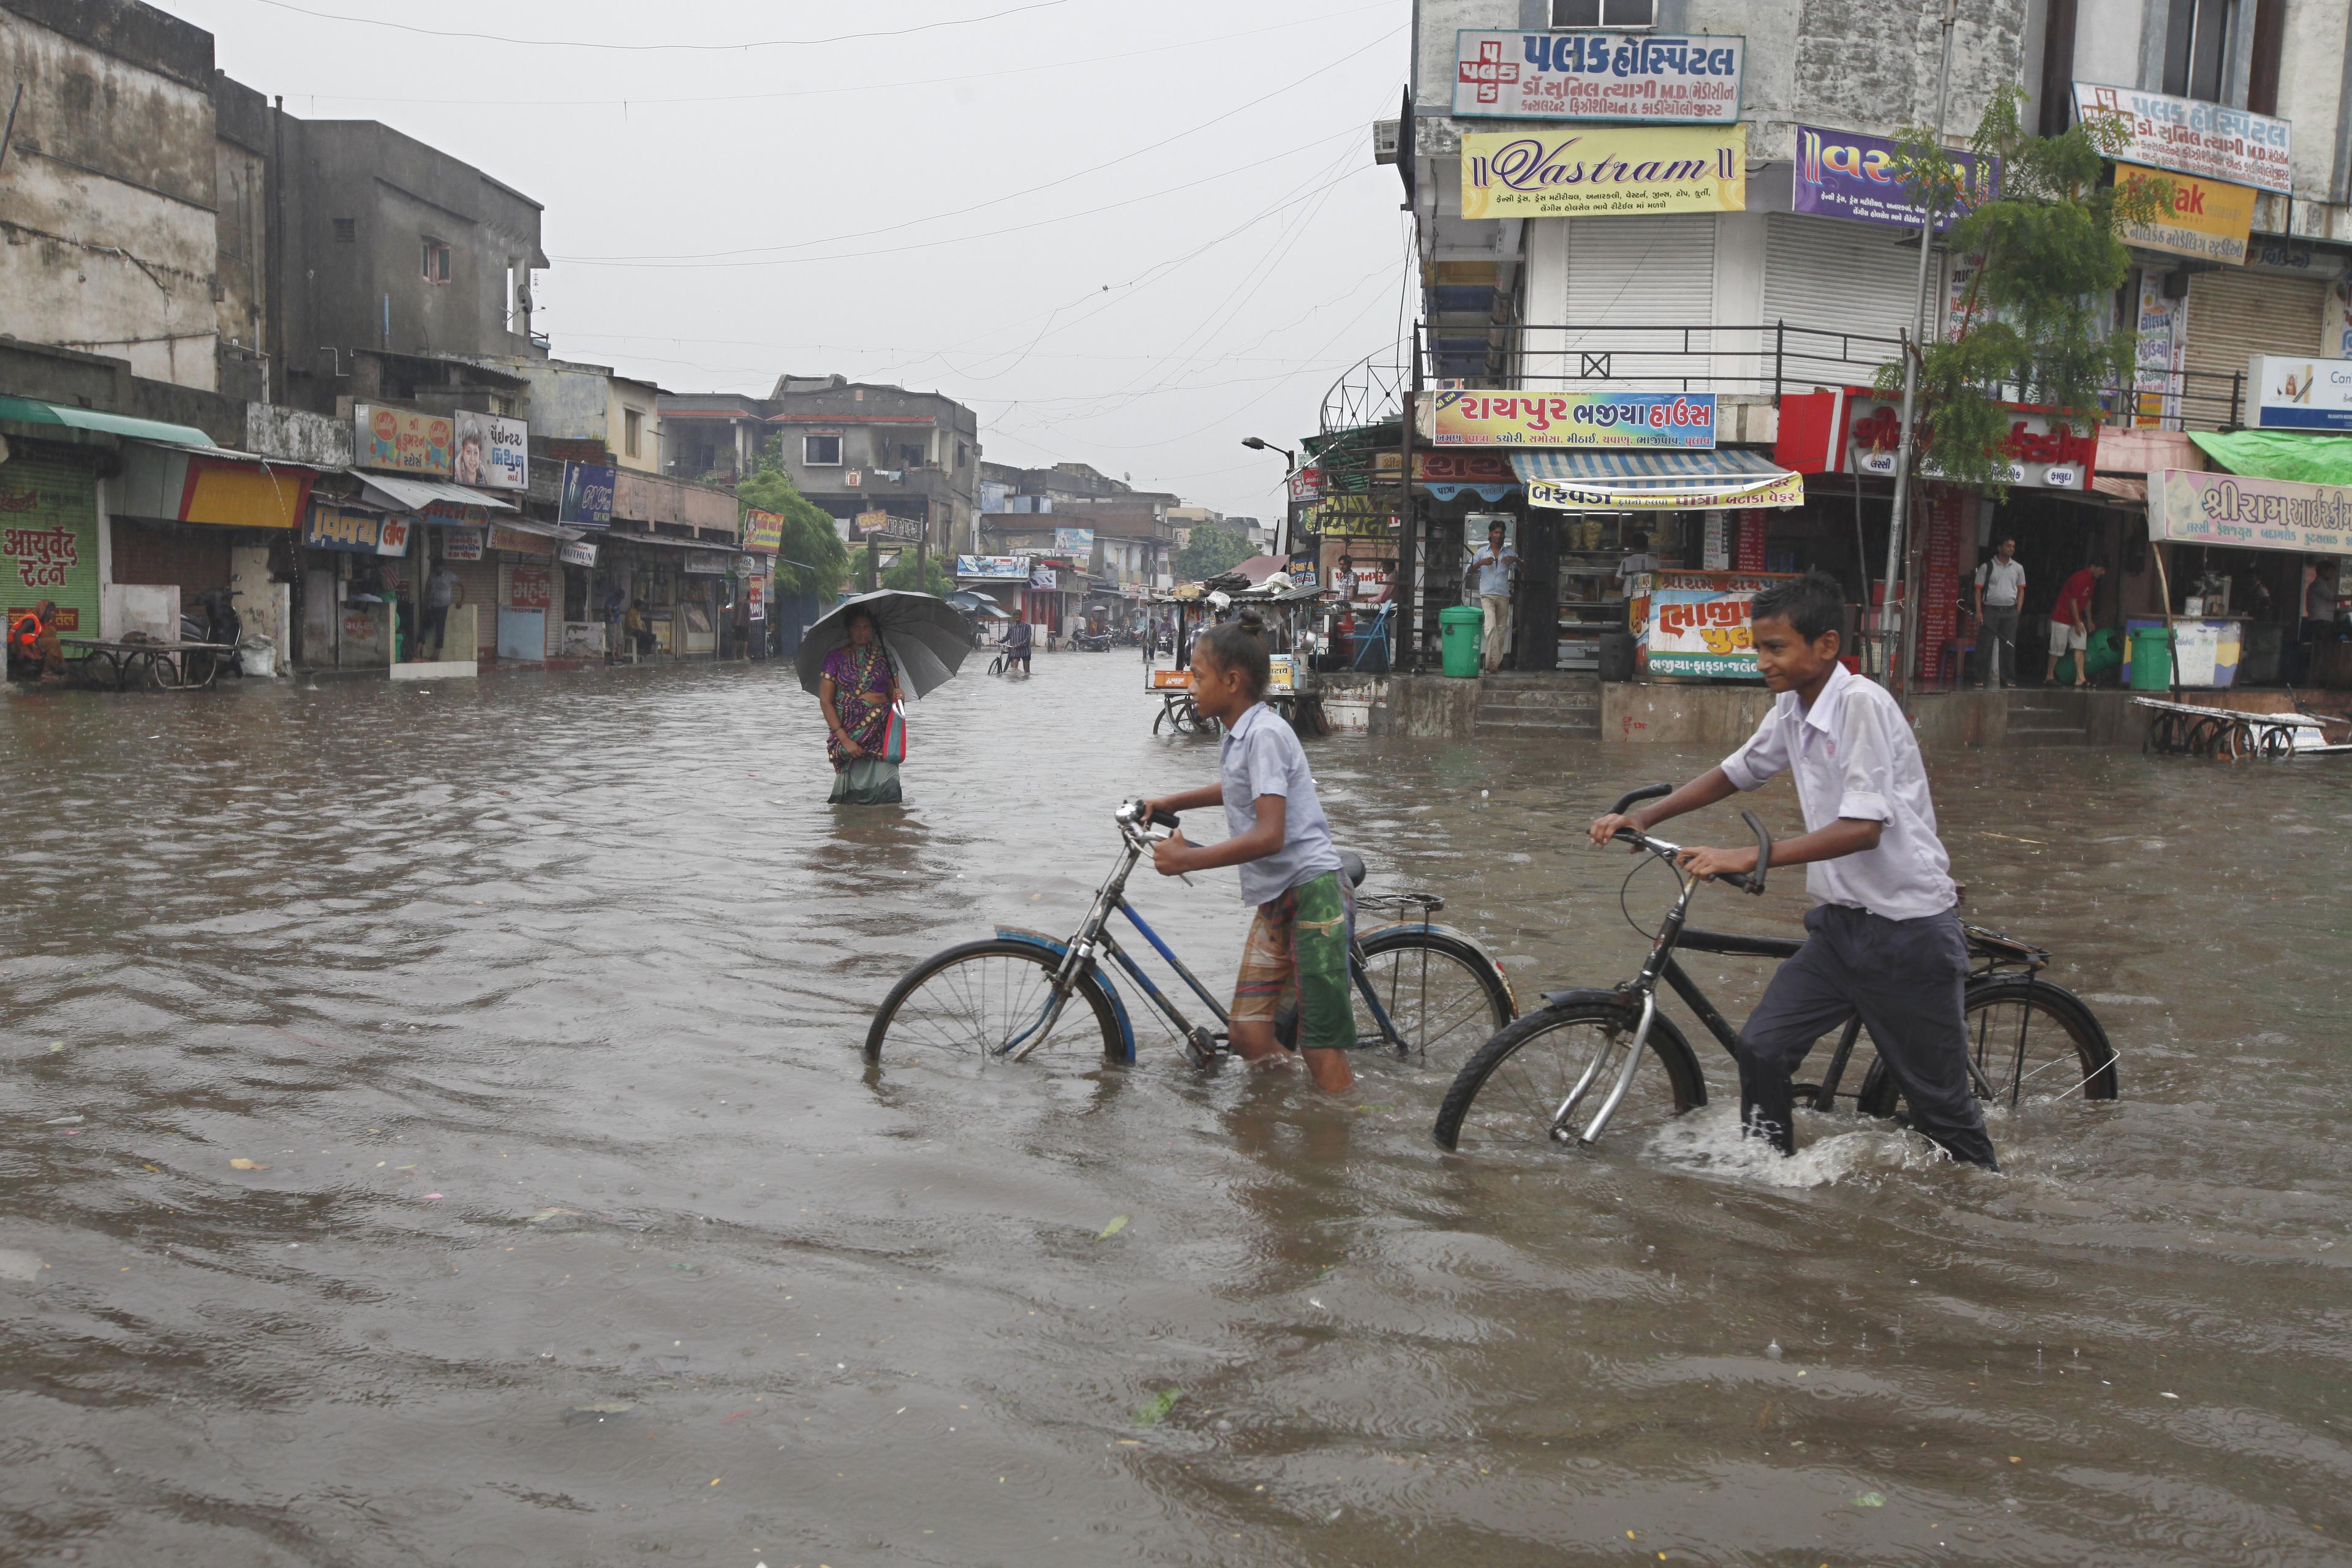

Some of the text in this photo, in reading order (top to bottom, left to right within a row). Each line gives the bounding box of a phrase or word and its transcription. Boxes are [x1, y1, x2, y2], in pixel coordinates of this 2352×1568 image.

[1523, 36, 1735, 77] પલક હોસ્પિટલ
[1461, 62, 1518, 80] પલક
[1603, 80, 1656, 99] ત્યાગી
[1660, 85, 1687, 99] M.D.
[1630, 103, 1637, 114] &
[2132, 97, 2286, 148] પલક હોસ્પિટલ
[1535, 194, 1546, 203] ડ્રેસ
[1564, 203, 1590, 211] હોલસેલ
[1460, 397, 1711, 431] રાયપુર ભજીયા હાઉસ
[3, 525, 78, 565] आयुर्वेद
[562, 547, 593, 561] MITHUN
[19, 559, 66, 587] रत्न
